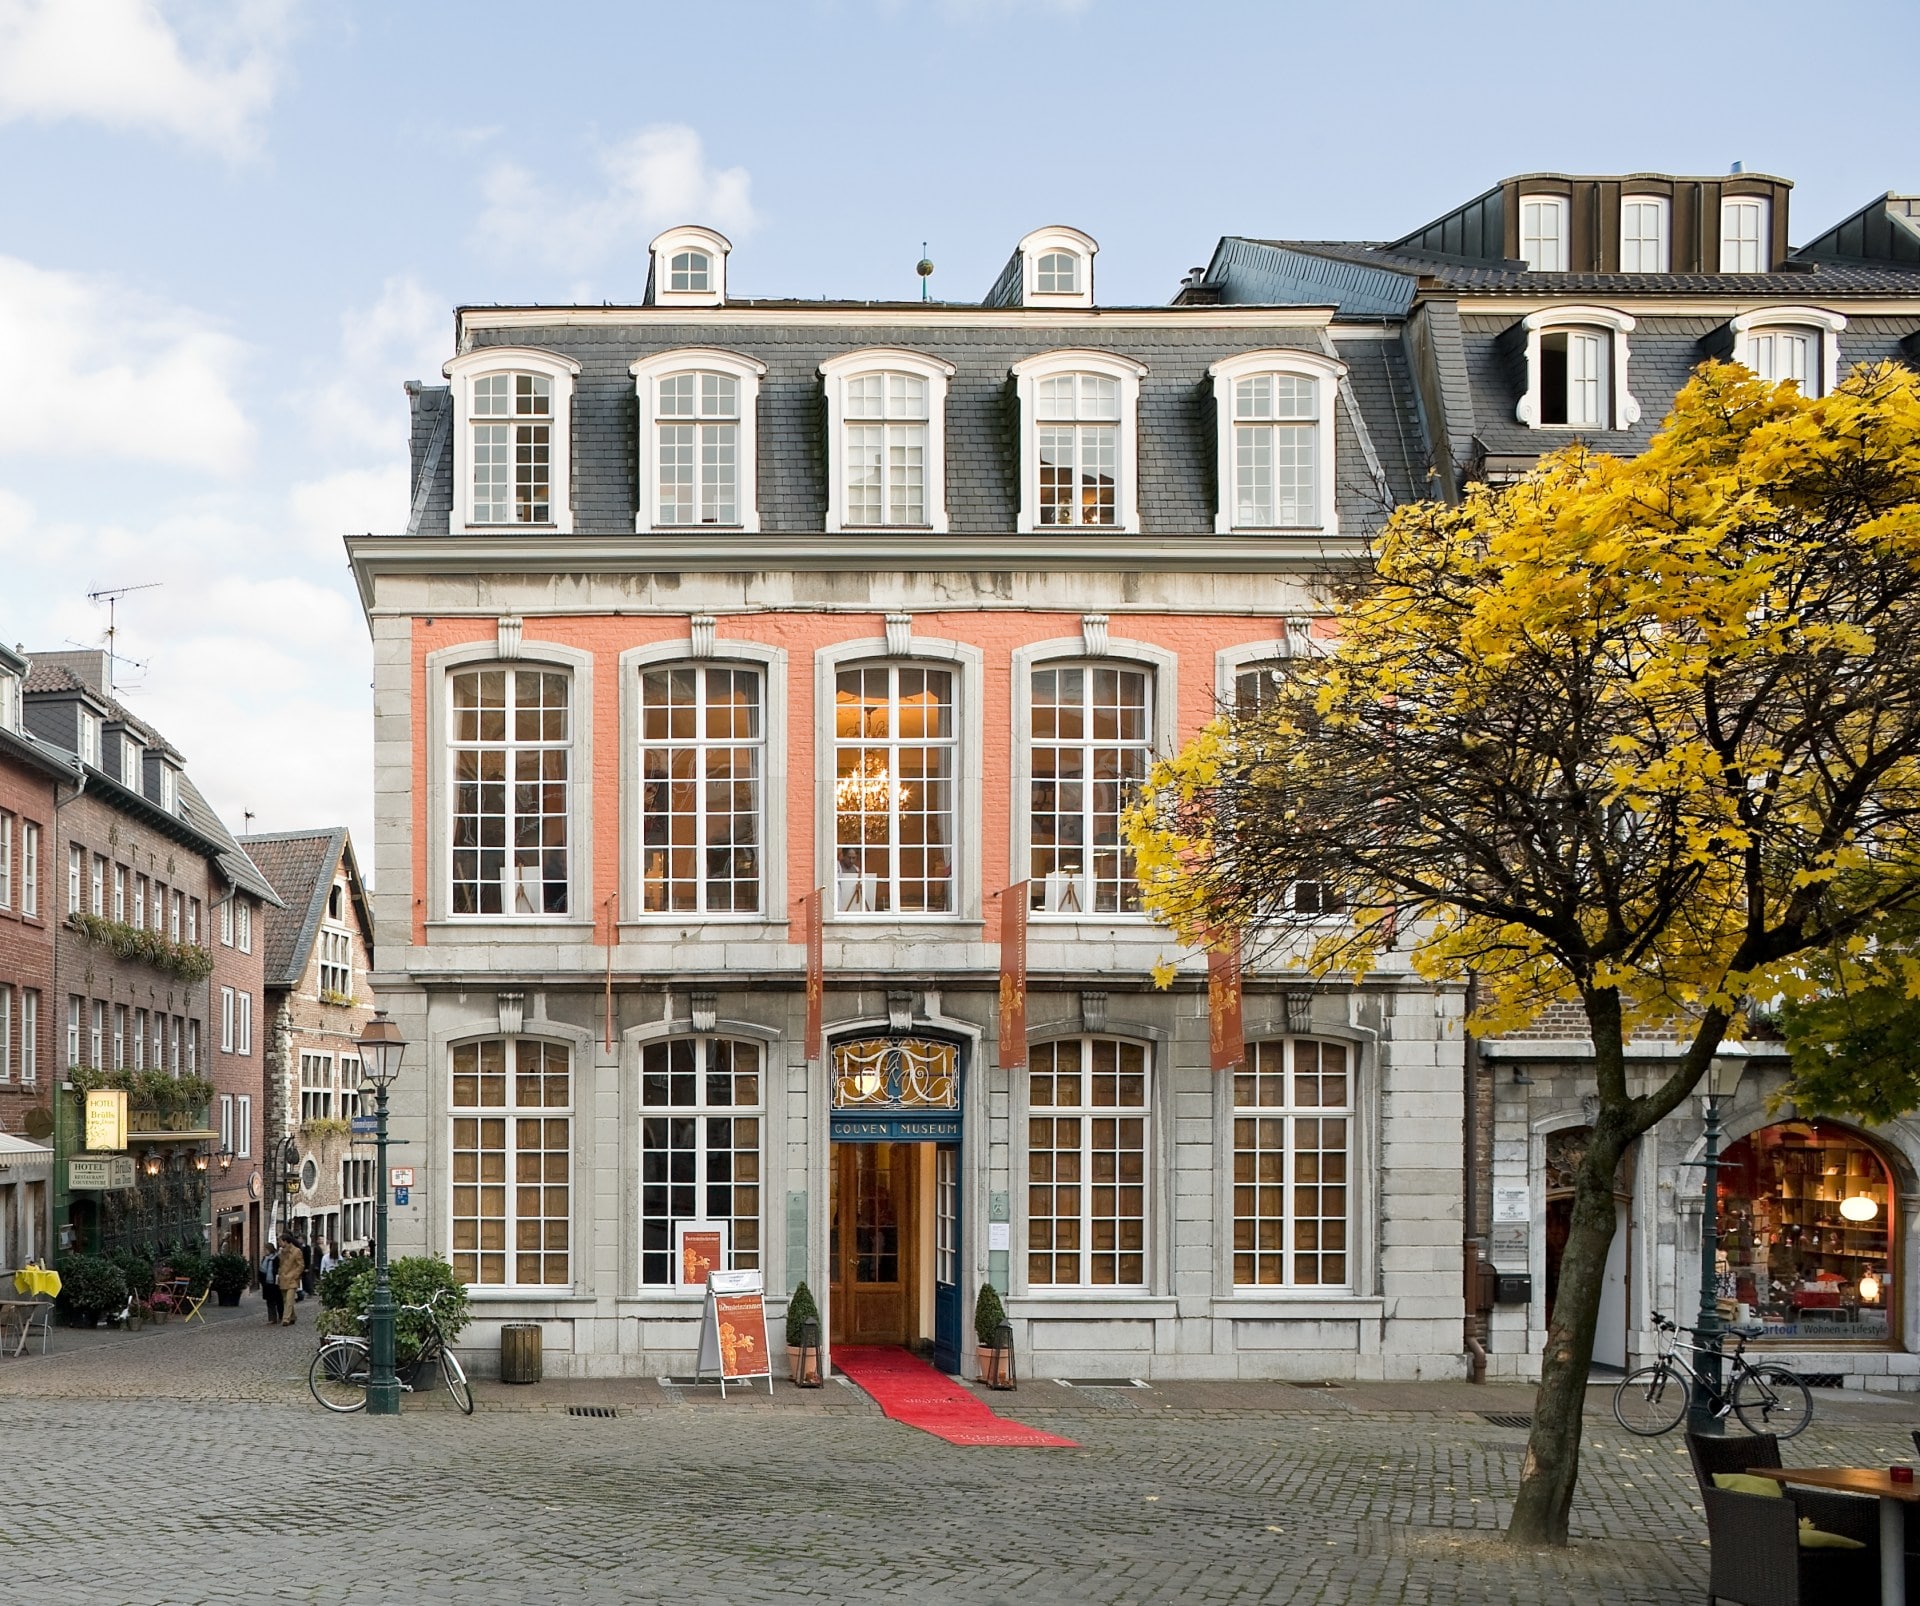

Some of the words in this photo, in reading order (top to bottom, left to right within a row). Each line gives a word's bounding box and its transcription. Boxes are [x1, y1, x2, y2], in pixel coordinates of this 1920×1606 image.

[900, 1123, 958, 1134] MUSEUM
[74, 1163, 105, 1171] HOTEL
[1803, 1324, 1841, 1335] Wohnen
[1852, 1324, 1888, 1337] Lifestyle
